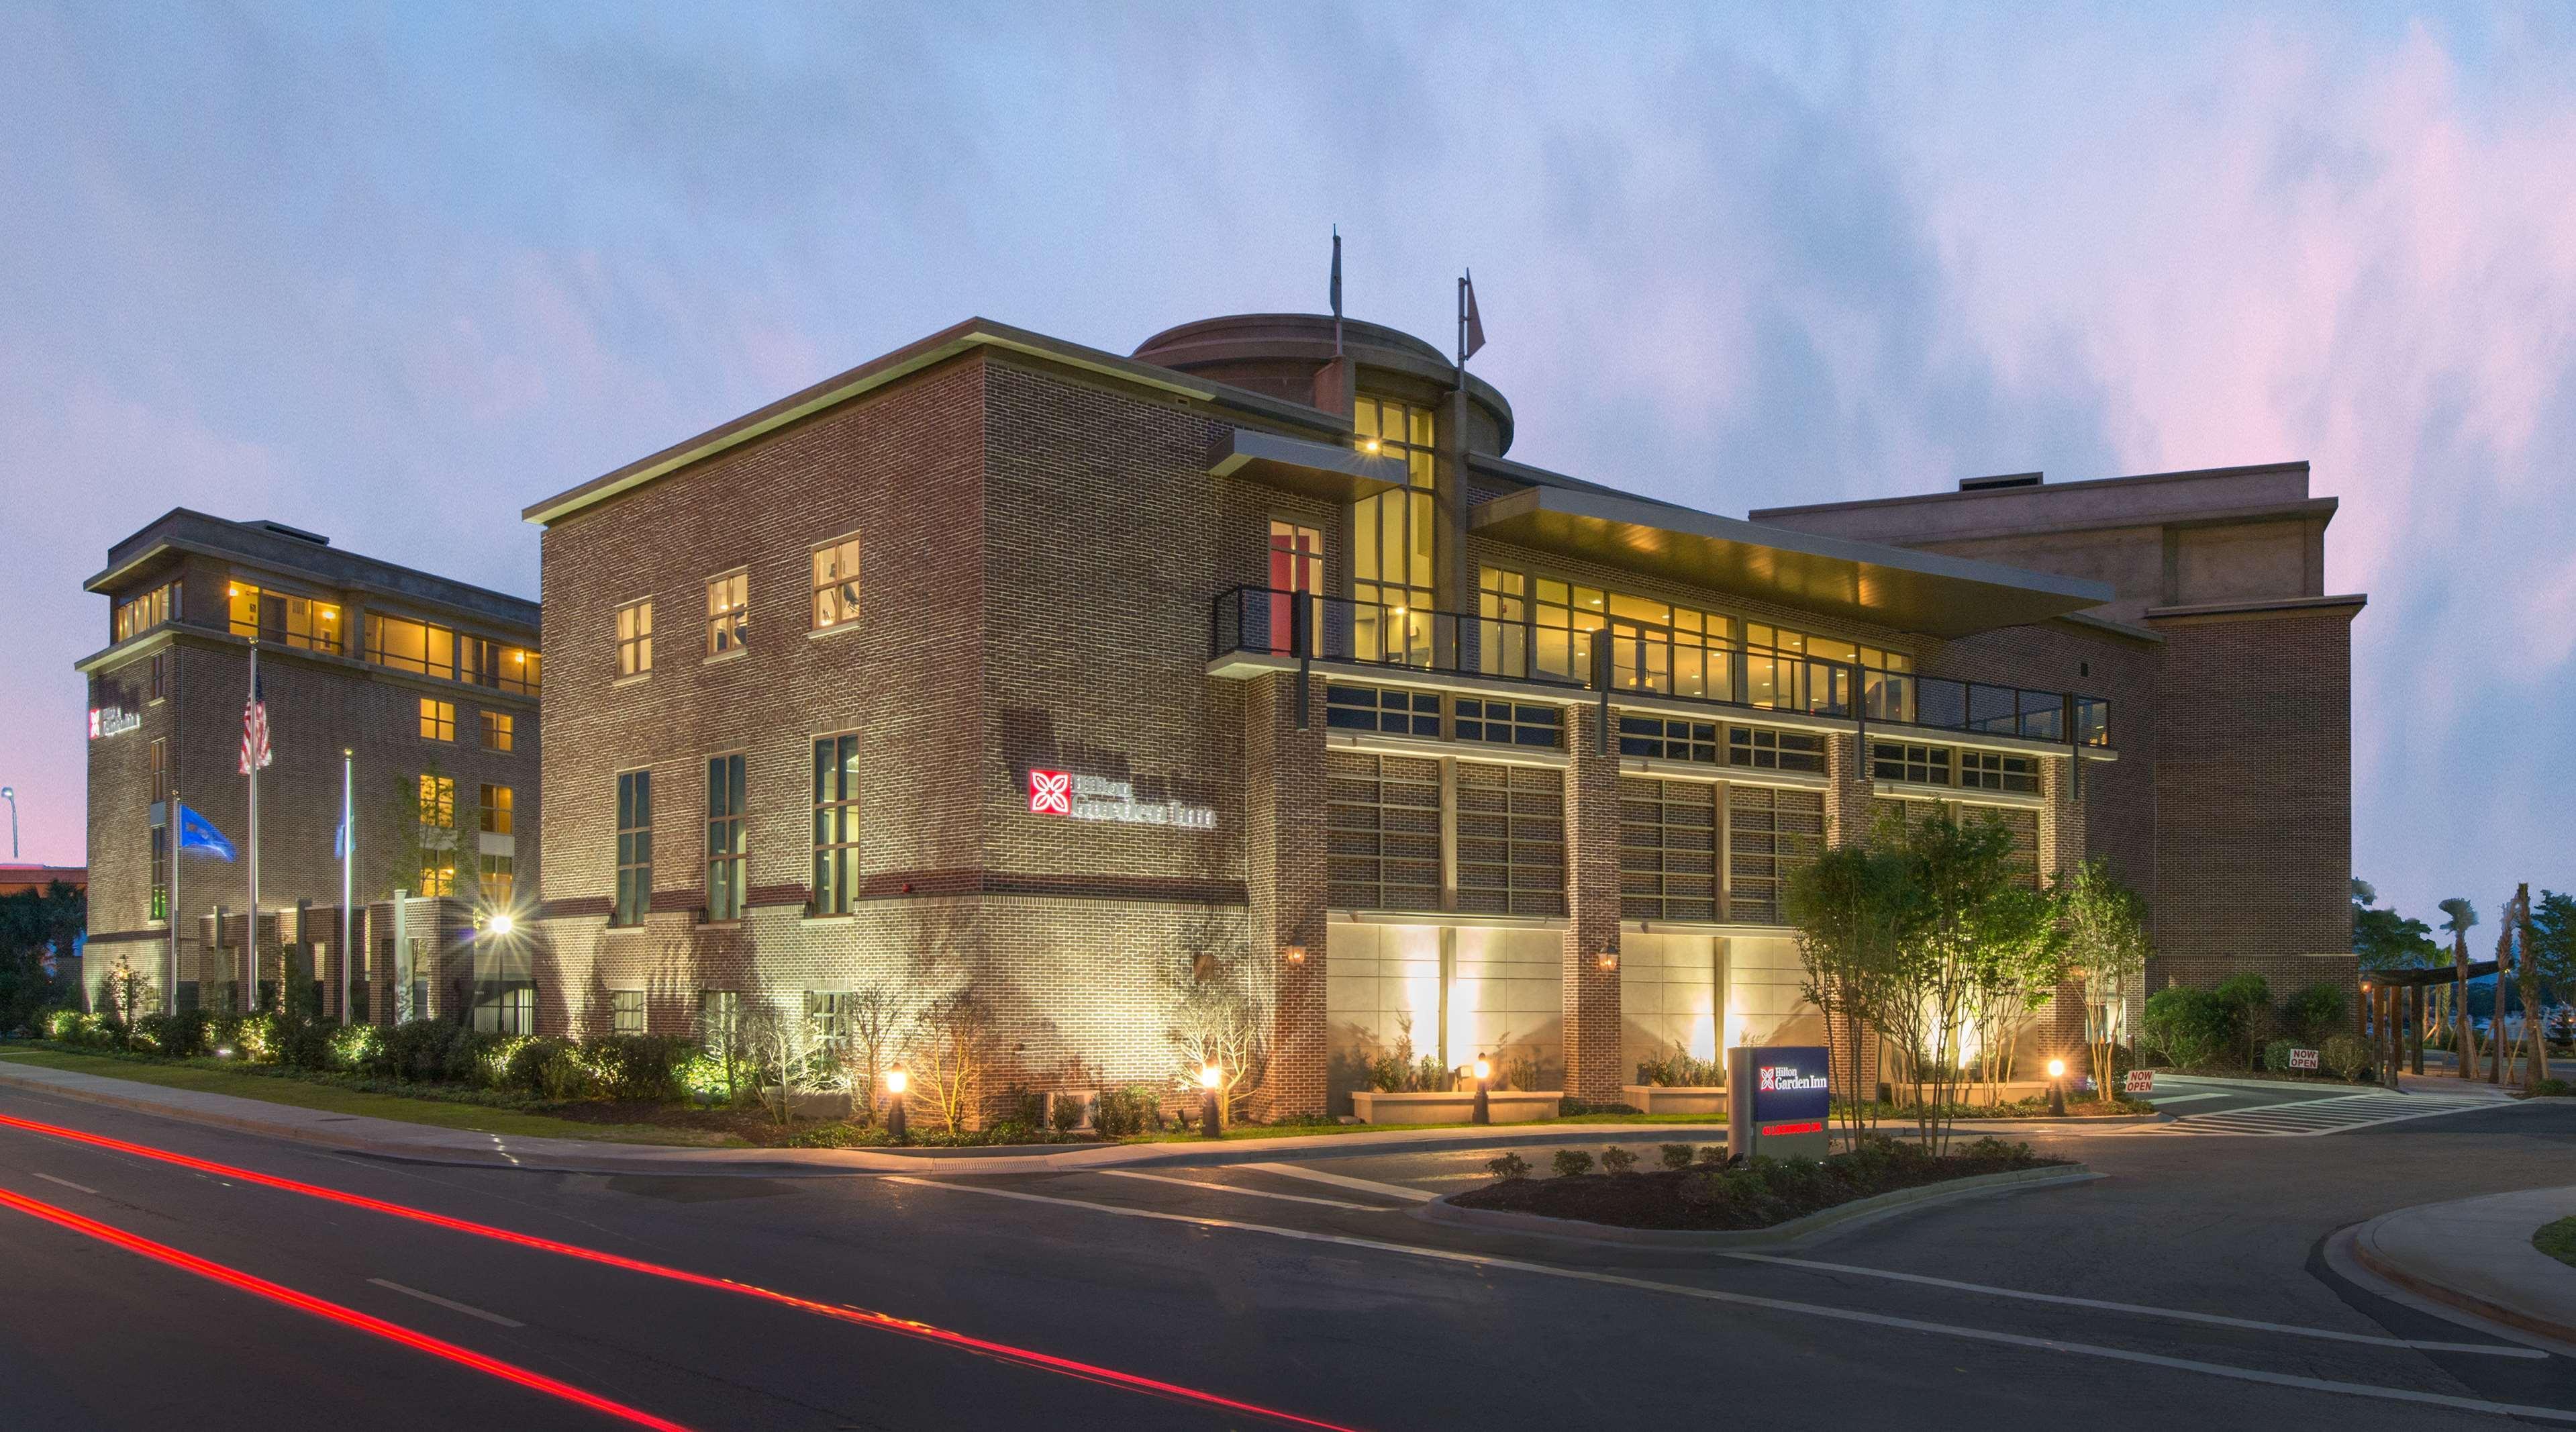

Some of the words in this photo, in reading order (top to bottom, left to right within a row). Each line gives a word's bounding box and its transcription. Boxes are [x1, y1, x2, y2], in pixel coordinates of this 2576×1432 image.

[1072, 794, 1168, 822] Garden
[1169, 801, 1218, 826] Inn
[2293, 1049, 2316, 1059] NOW
[2291, 1059, 2317, 1067] OPEN
[1775, 1067, 1797, 1077] Hilton
[2131, 1071, 2152, 1081] NOW
[1775, 1076, 1810, 1090] Garden
[1810, 1075, 1827, 1088] Inn
[2127, 1082, 2152, 1092] OPEN
